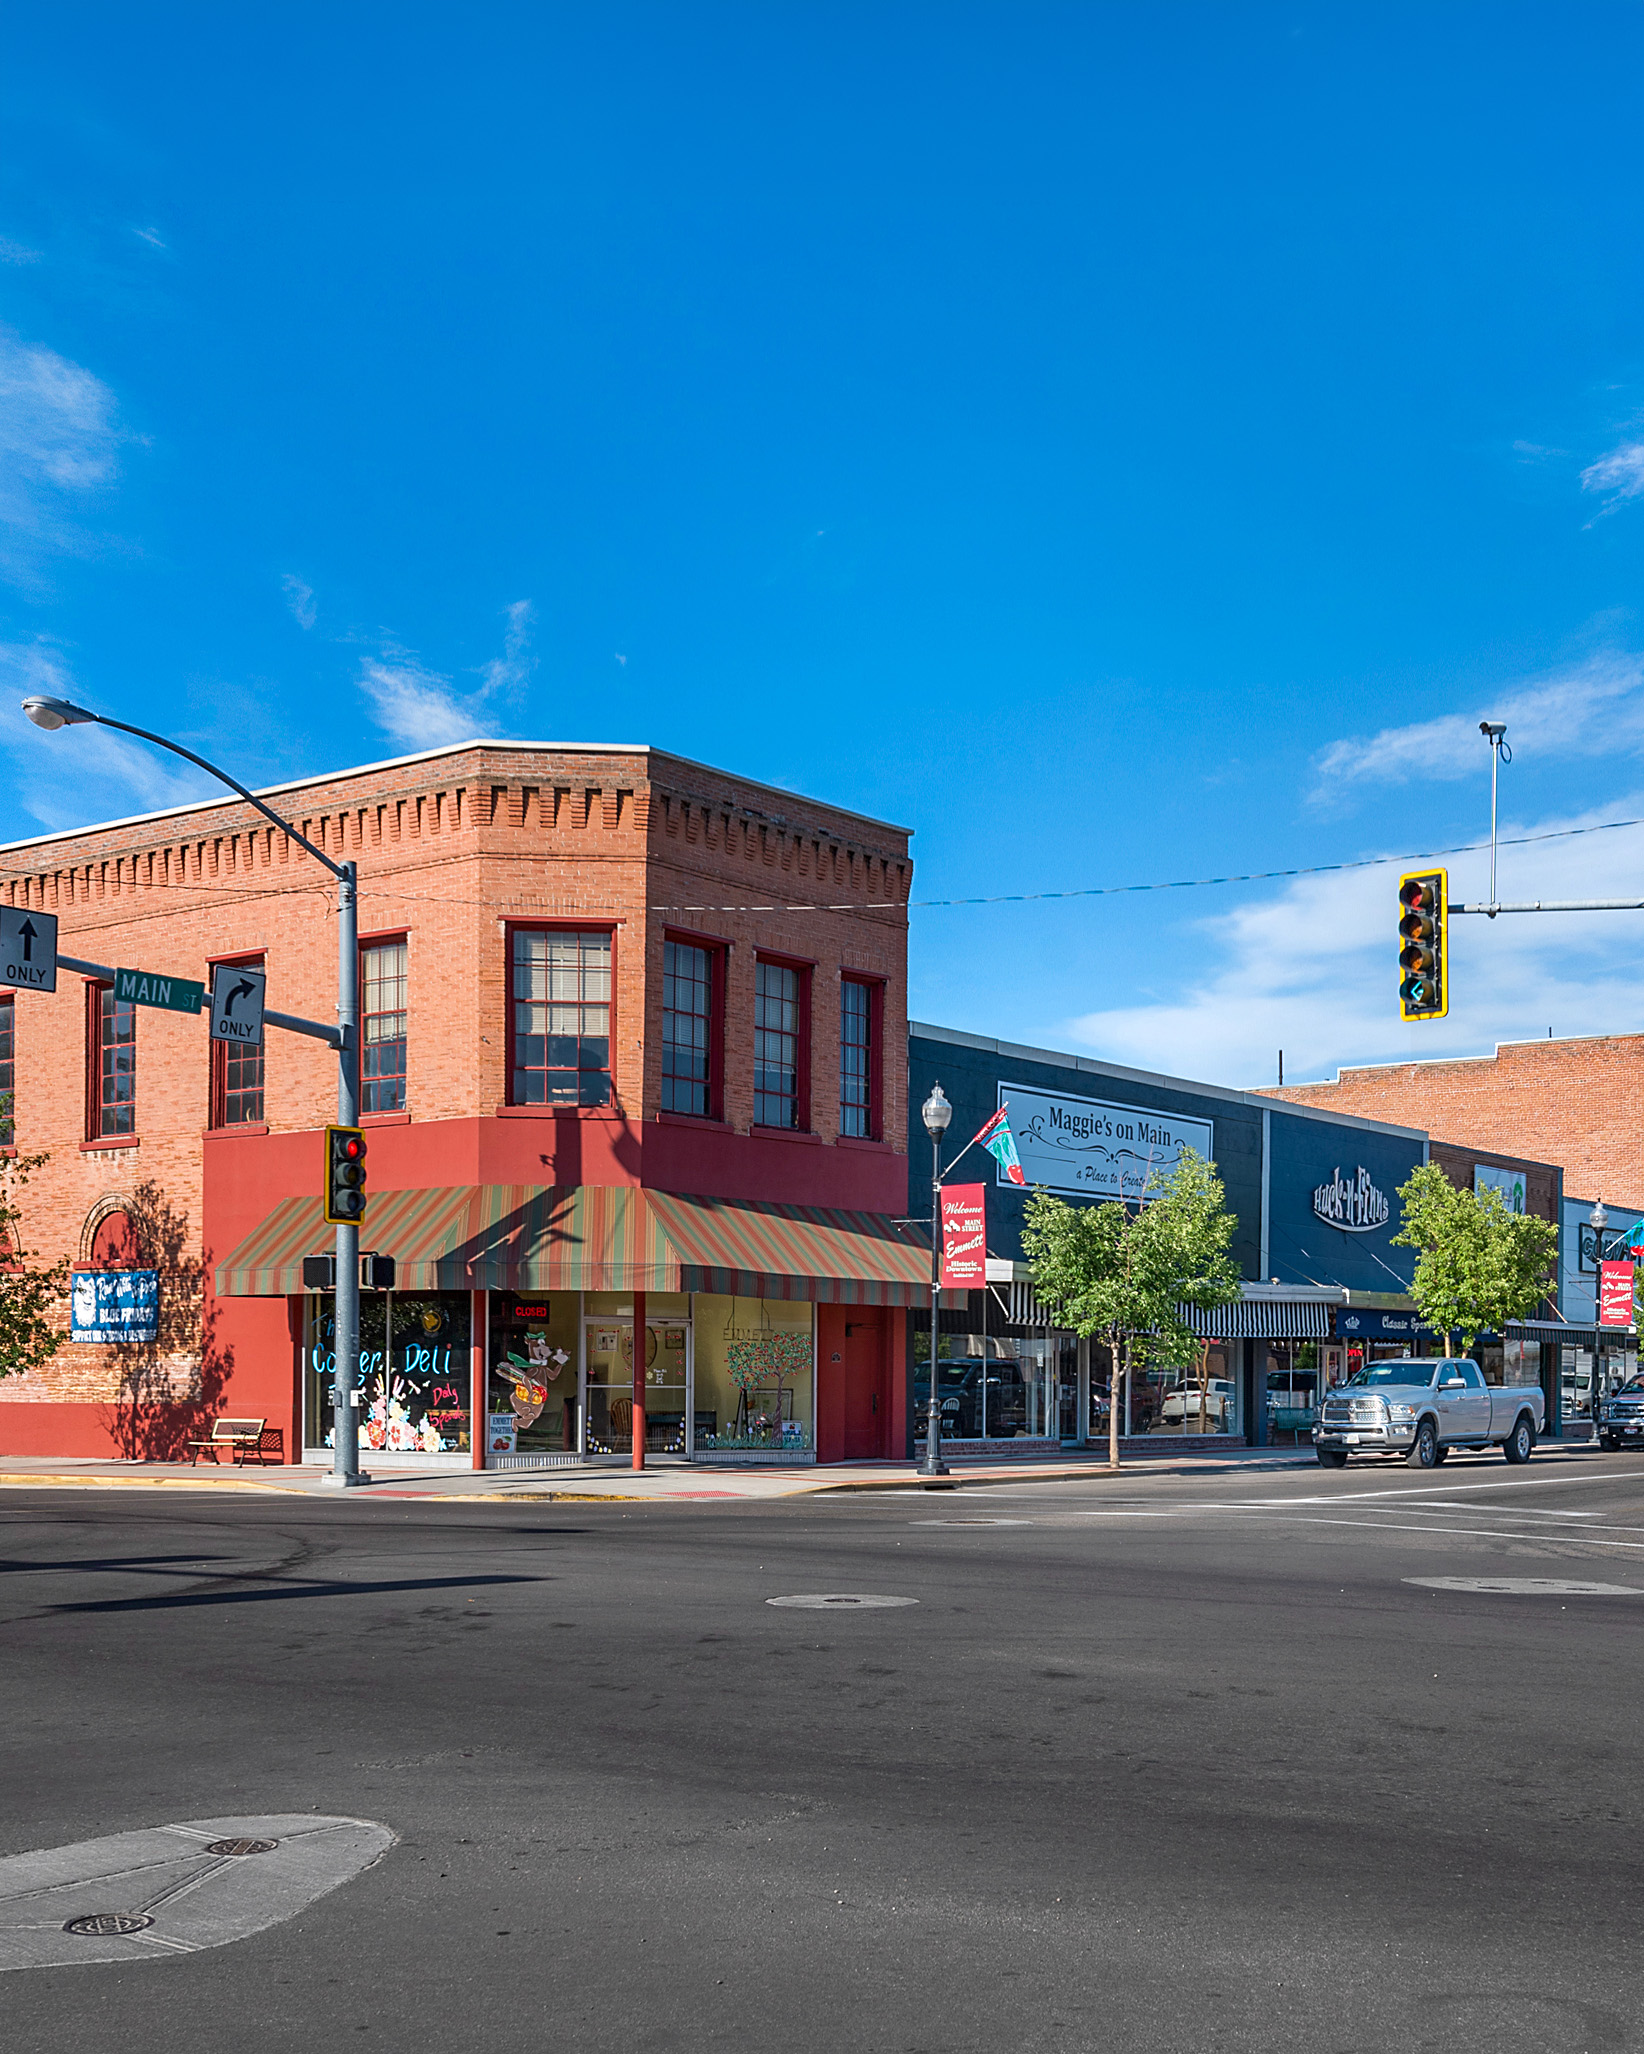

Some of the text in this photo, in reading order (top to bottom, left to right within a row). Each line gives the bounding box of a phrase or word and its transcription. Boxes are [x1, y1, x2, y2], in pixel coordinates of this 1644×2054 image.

[6, 964, 47, 984] ONLY
[120, 974, 198, 1009] MAIN ST
[219, 1019, 254, 1038] ONLY
[1049, 1106, 1171, 1148] Maggie's on Main
[1076, 1169, 1082, 1180] a
[1085, 1165, 1107, 1183] Place
[1110, 1170, 1118, 1184] to
[943, 1201, 983, 1215] Welcome
[946, 1233, 984, 1259] Emmett
[99, 1308, 120, 1323] BLUE
[515, 1306, 547, 1317] CLOSED
[311, 1313, 336, 1338] Th
[1382, 1316, 1408, 1330] Classic
[312, 1342, 452, 1374] Coer Deli
[1347, 1348, 1364, 1357] OPEN
